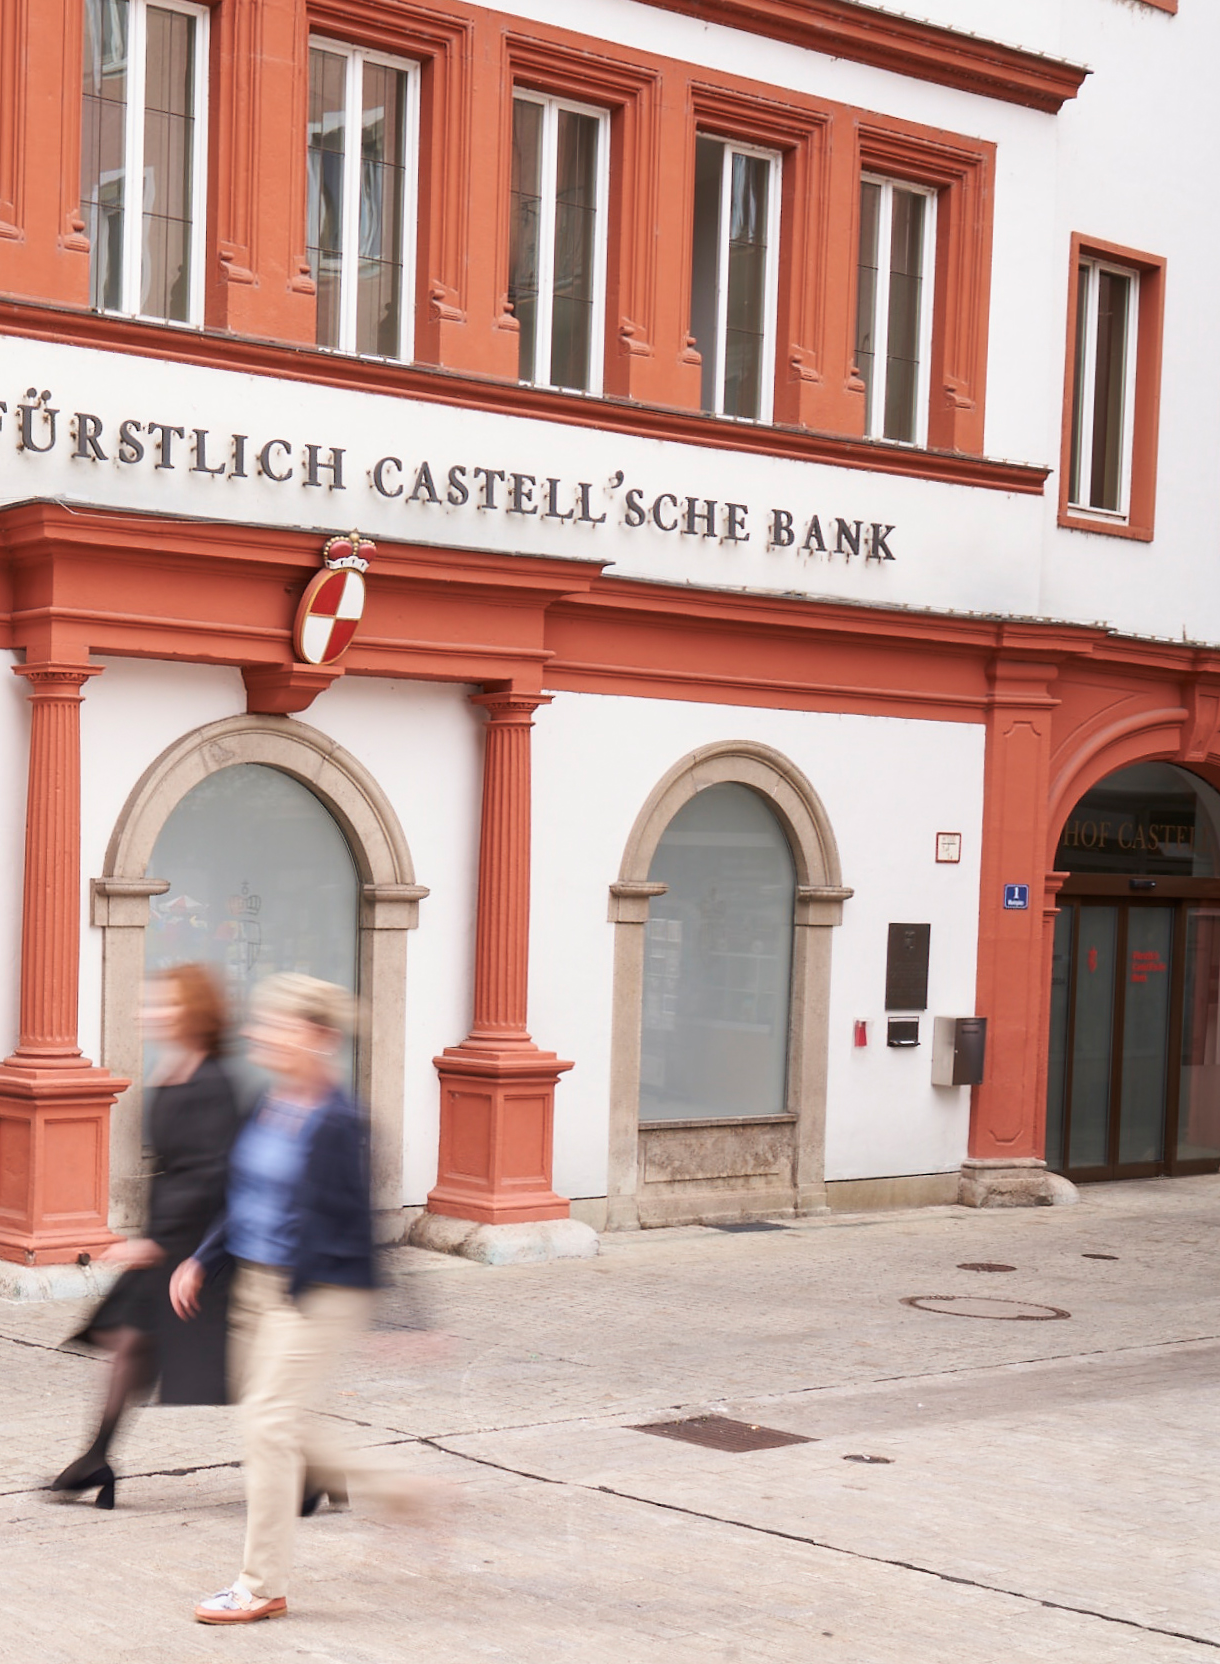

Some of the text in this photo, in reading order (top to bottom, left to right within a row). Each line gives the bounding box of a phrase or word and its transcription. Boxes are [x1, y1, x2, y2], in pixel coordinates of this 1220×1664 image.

[770, 508, 896, 561] BANK
[1063, 820, 1112, 848] HOF
[1013, 886, 1020, 899] 1
